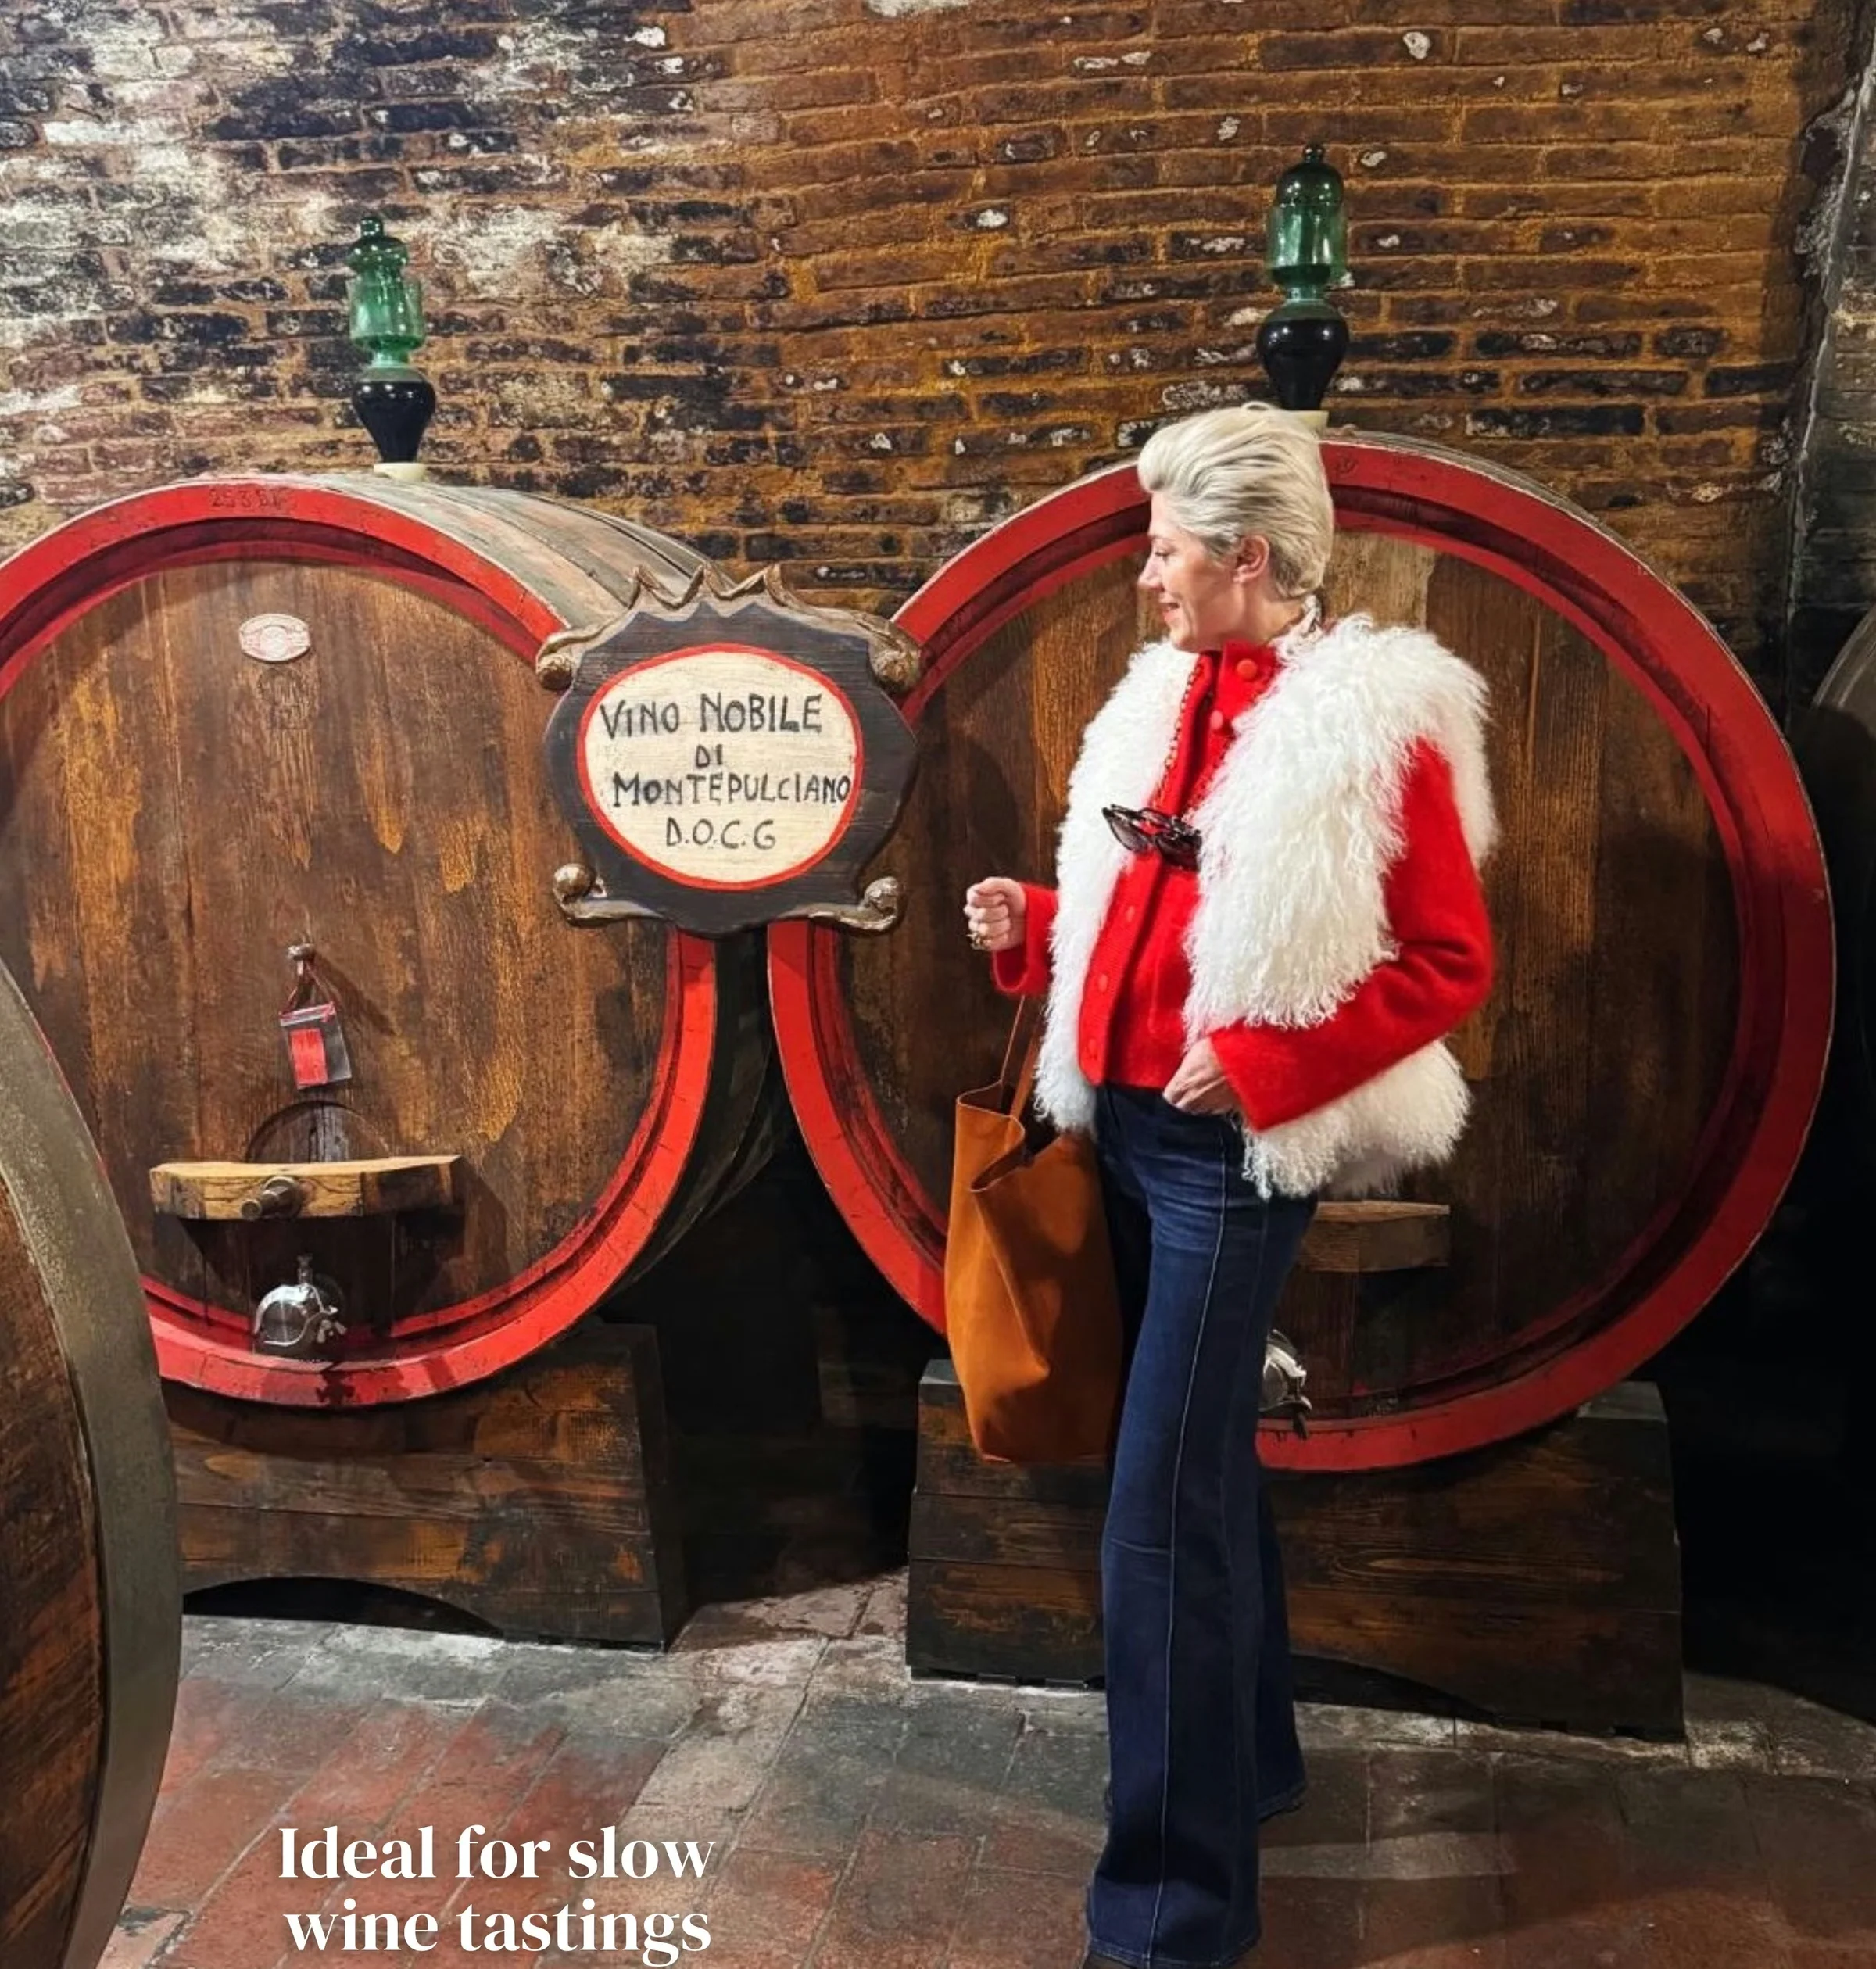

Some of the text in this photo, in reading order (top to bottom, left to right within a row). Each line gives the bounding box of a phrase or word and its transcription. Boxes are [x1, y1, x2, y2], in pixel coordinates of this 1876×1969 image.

[600, 692, 822, 739] VINO NOBILE
[695, 743, 724, 768] DI
[612, 771, 851, 807] MONTEPULCIANO
[666, 816, 776, 850] D.O.C.G
